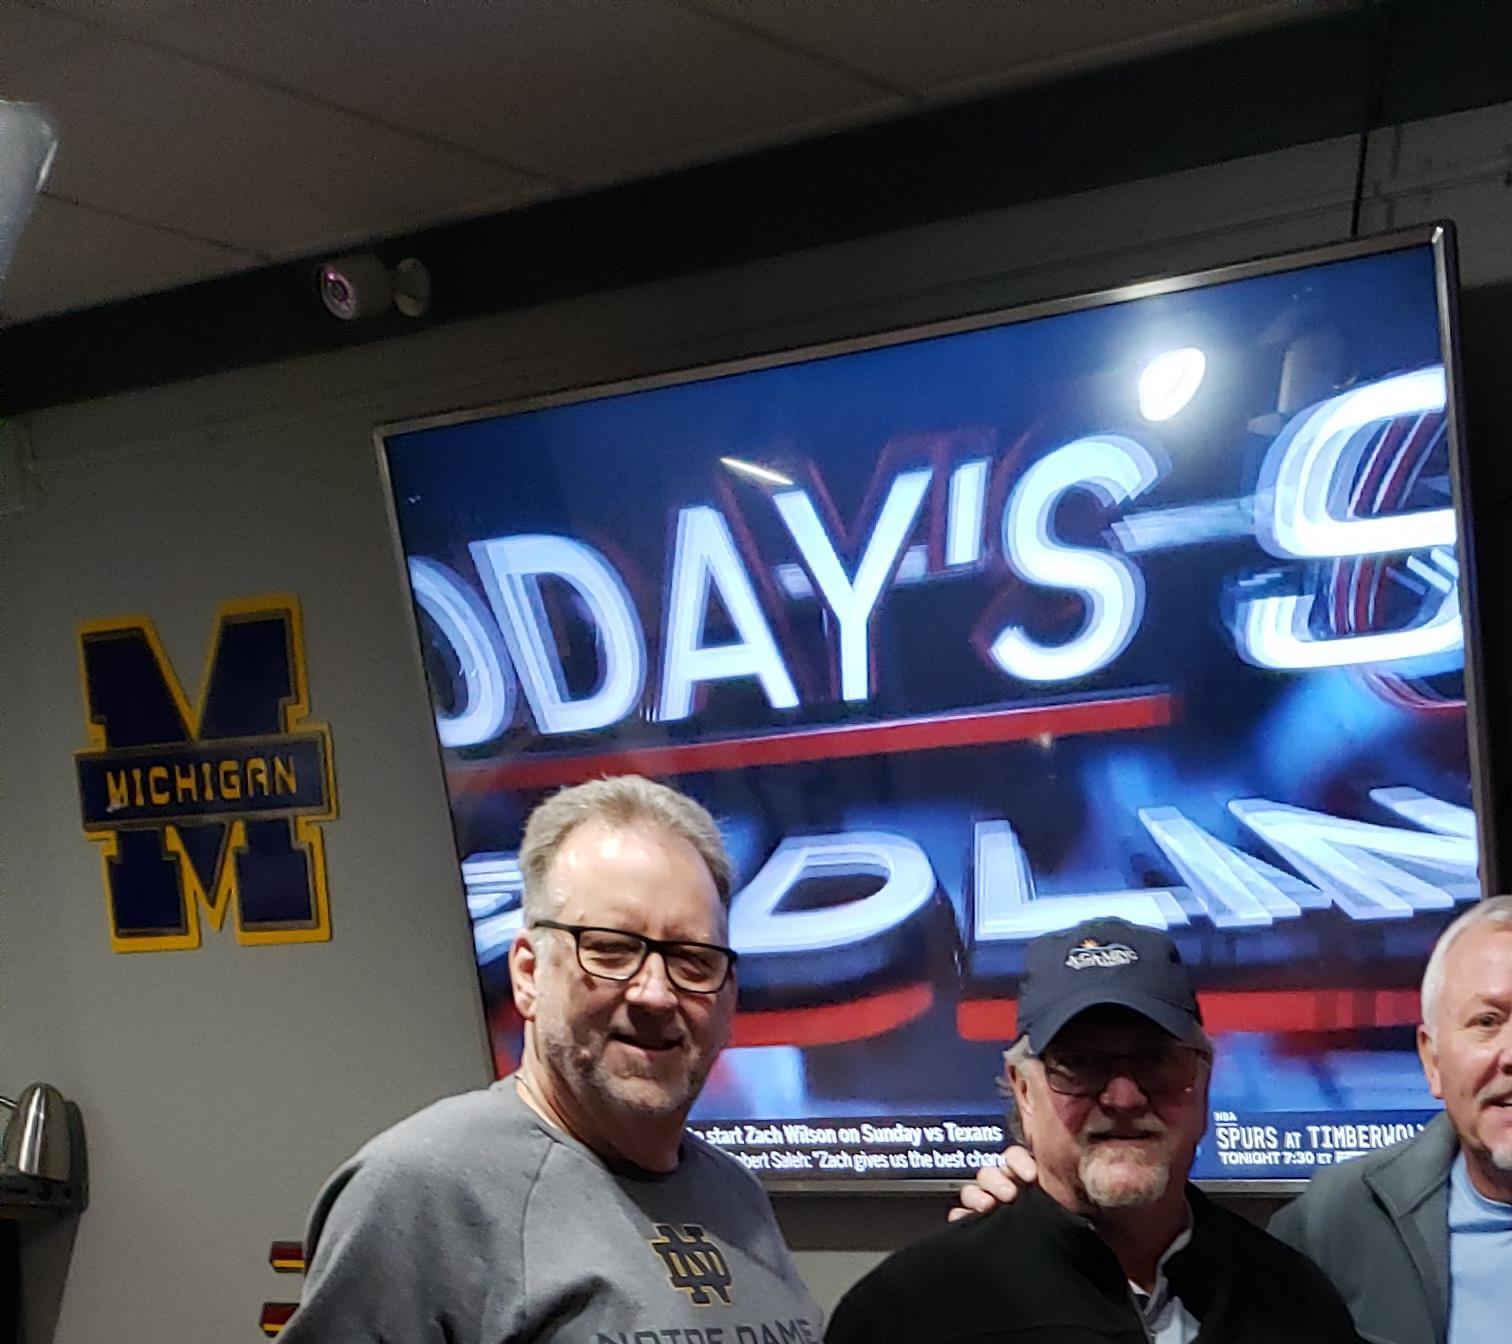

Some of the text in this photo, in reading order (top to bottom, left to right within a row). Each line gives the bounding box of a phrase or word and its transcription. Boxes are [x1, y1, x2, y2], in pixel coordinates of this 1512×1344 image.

[104, 755, 298, 809] MICHIGAN
[1214, 1112, 1237, 1121] NBA
[706, 1126, 744, 1145] start
[745, 1125, 783, 1144] Zach
[784, 1124, 836, 1144] Wilson
[838, 1127, 860, 1143] on
[861, 1123, 921, 1146] Sunday
[923, 1126, 944, 1142] vs
[943, 1122, 1003, 1142] Texans
[1216, 1123, 1425, 1149] SPURS AT TIMBERWO
[728, 1151, 770, 1169] bert
[771, 1150, 811, 1169] Saleh:
[853, 1150, 889, 1172] gives
[890, 1152, 909, 1168] us
[908, 1149, 933, 1168] the
[934, 1149, 966, 1168] best
[1218, 1151, 1281, 1165] TONIGHT
[1283, 1151, 1315, 1164] 7:30
